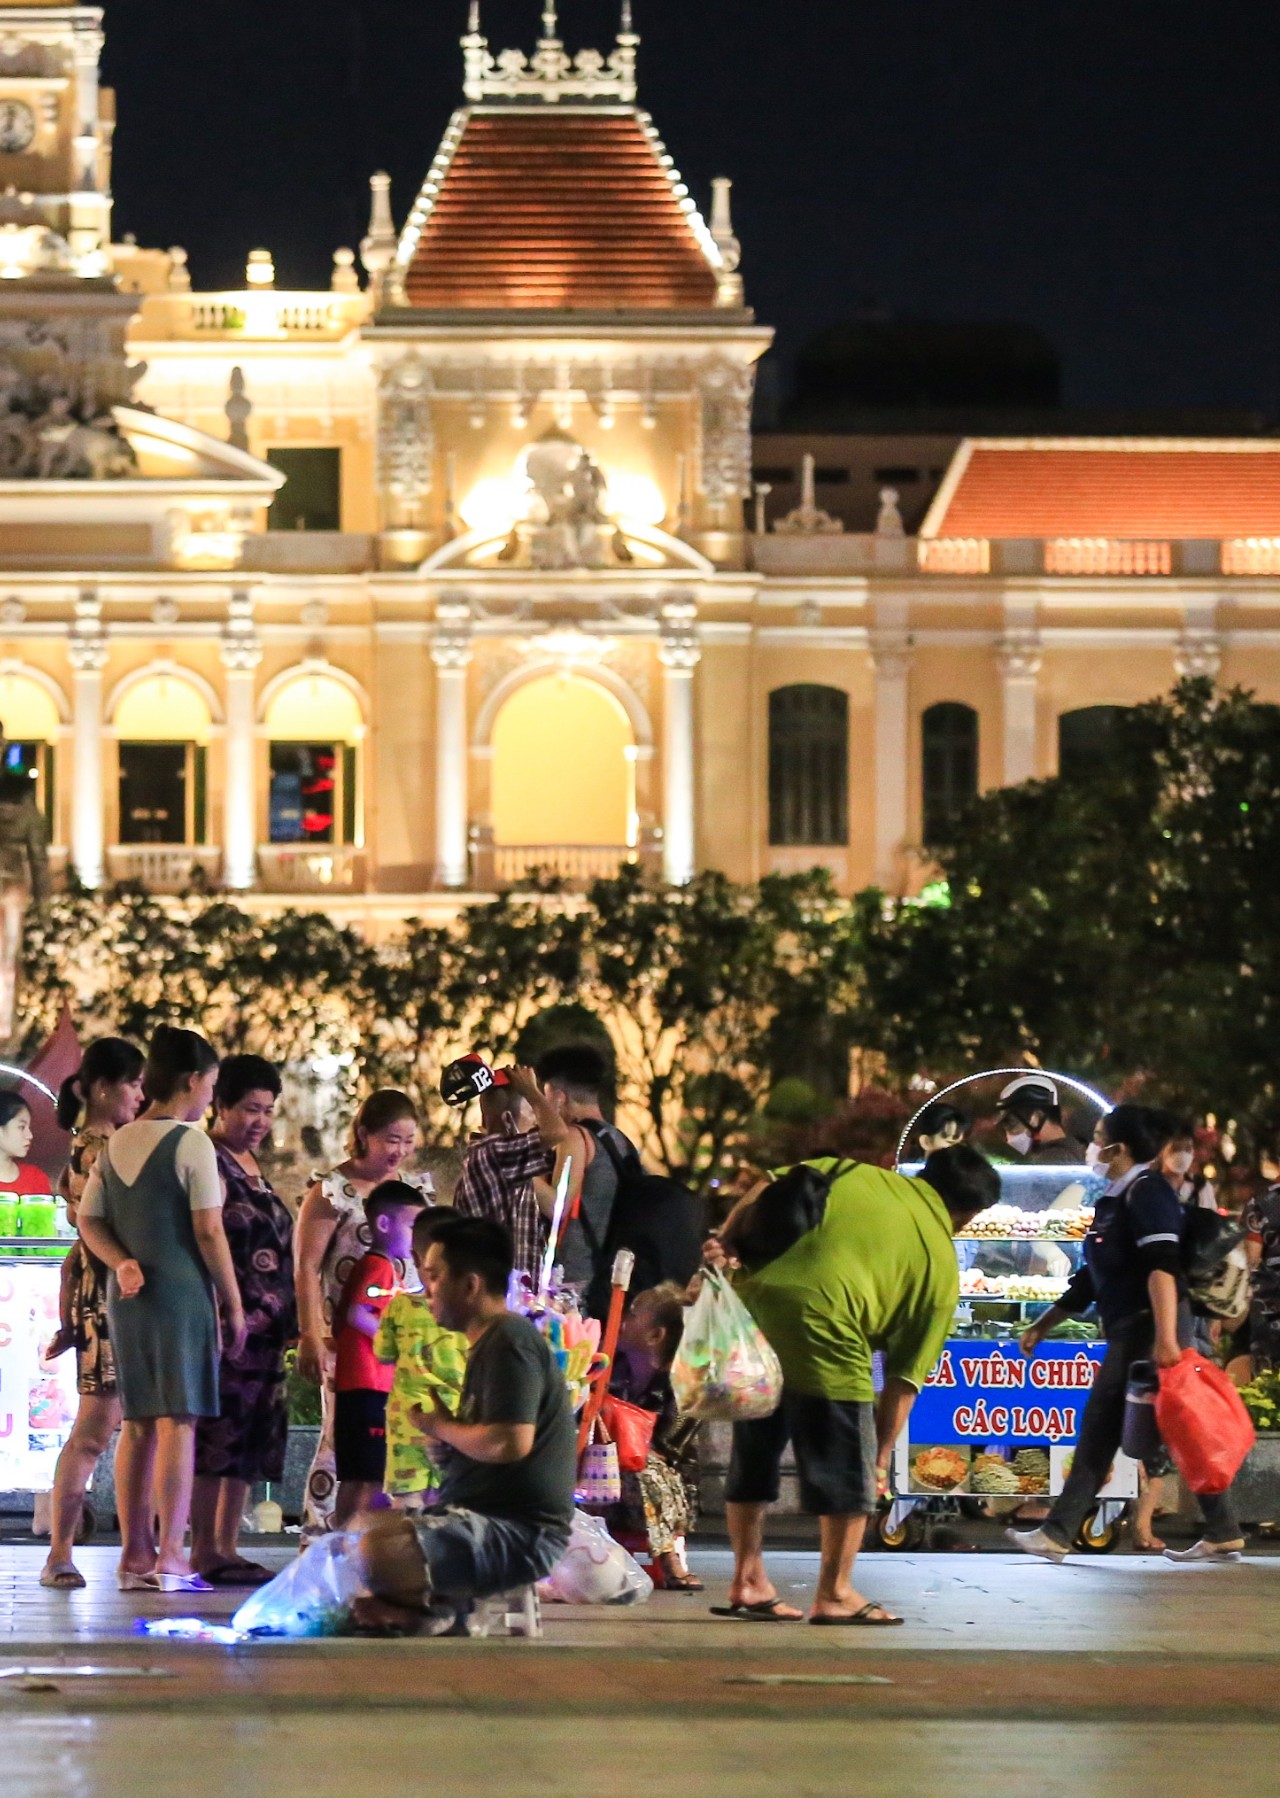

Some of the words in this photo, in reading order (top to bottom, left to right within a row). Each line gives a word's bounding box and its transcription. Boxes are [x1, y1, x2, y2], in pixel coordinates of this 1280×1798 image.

[961, 1352, 1025, 1386] VIÊN
[954, 1400, 1007, 1434] CÁC
[1013, 1407, 1074, 1440] LOẠI
